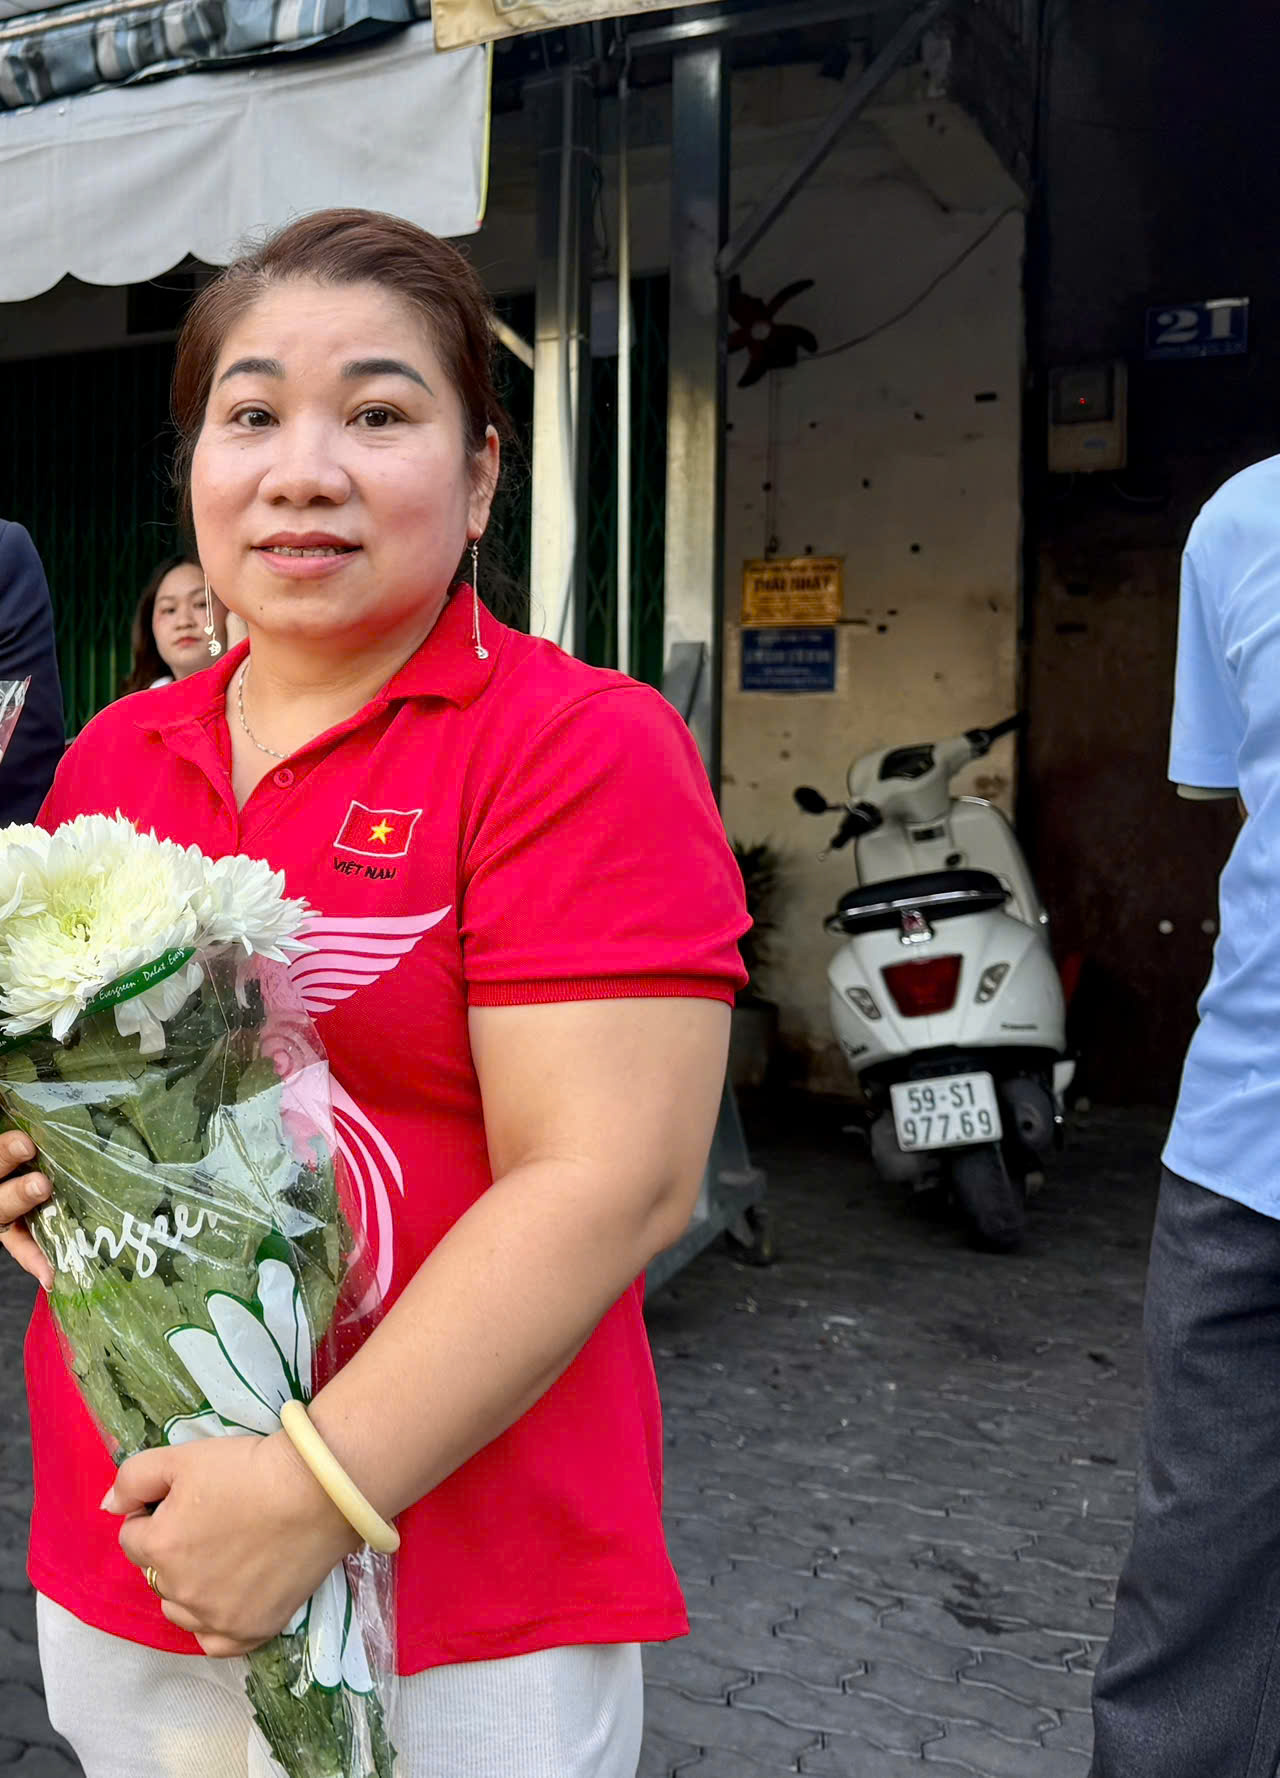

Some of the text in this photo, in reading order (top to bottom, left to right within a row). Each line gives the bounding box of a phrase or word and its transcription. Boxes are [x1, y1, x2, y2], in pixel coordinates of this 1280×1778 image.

[1156, 303, 1233, 344] 21
[908, 1082, 975, 1114] 59-S1
[903, 1109, 993, 1145] 977.69
